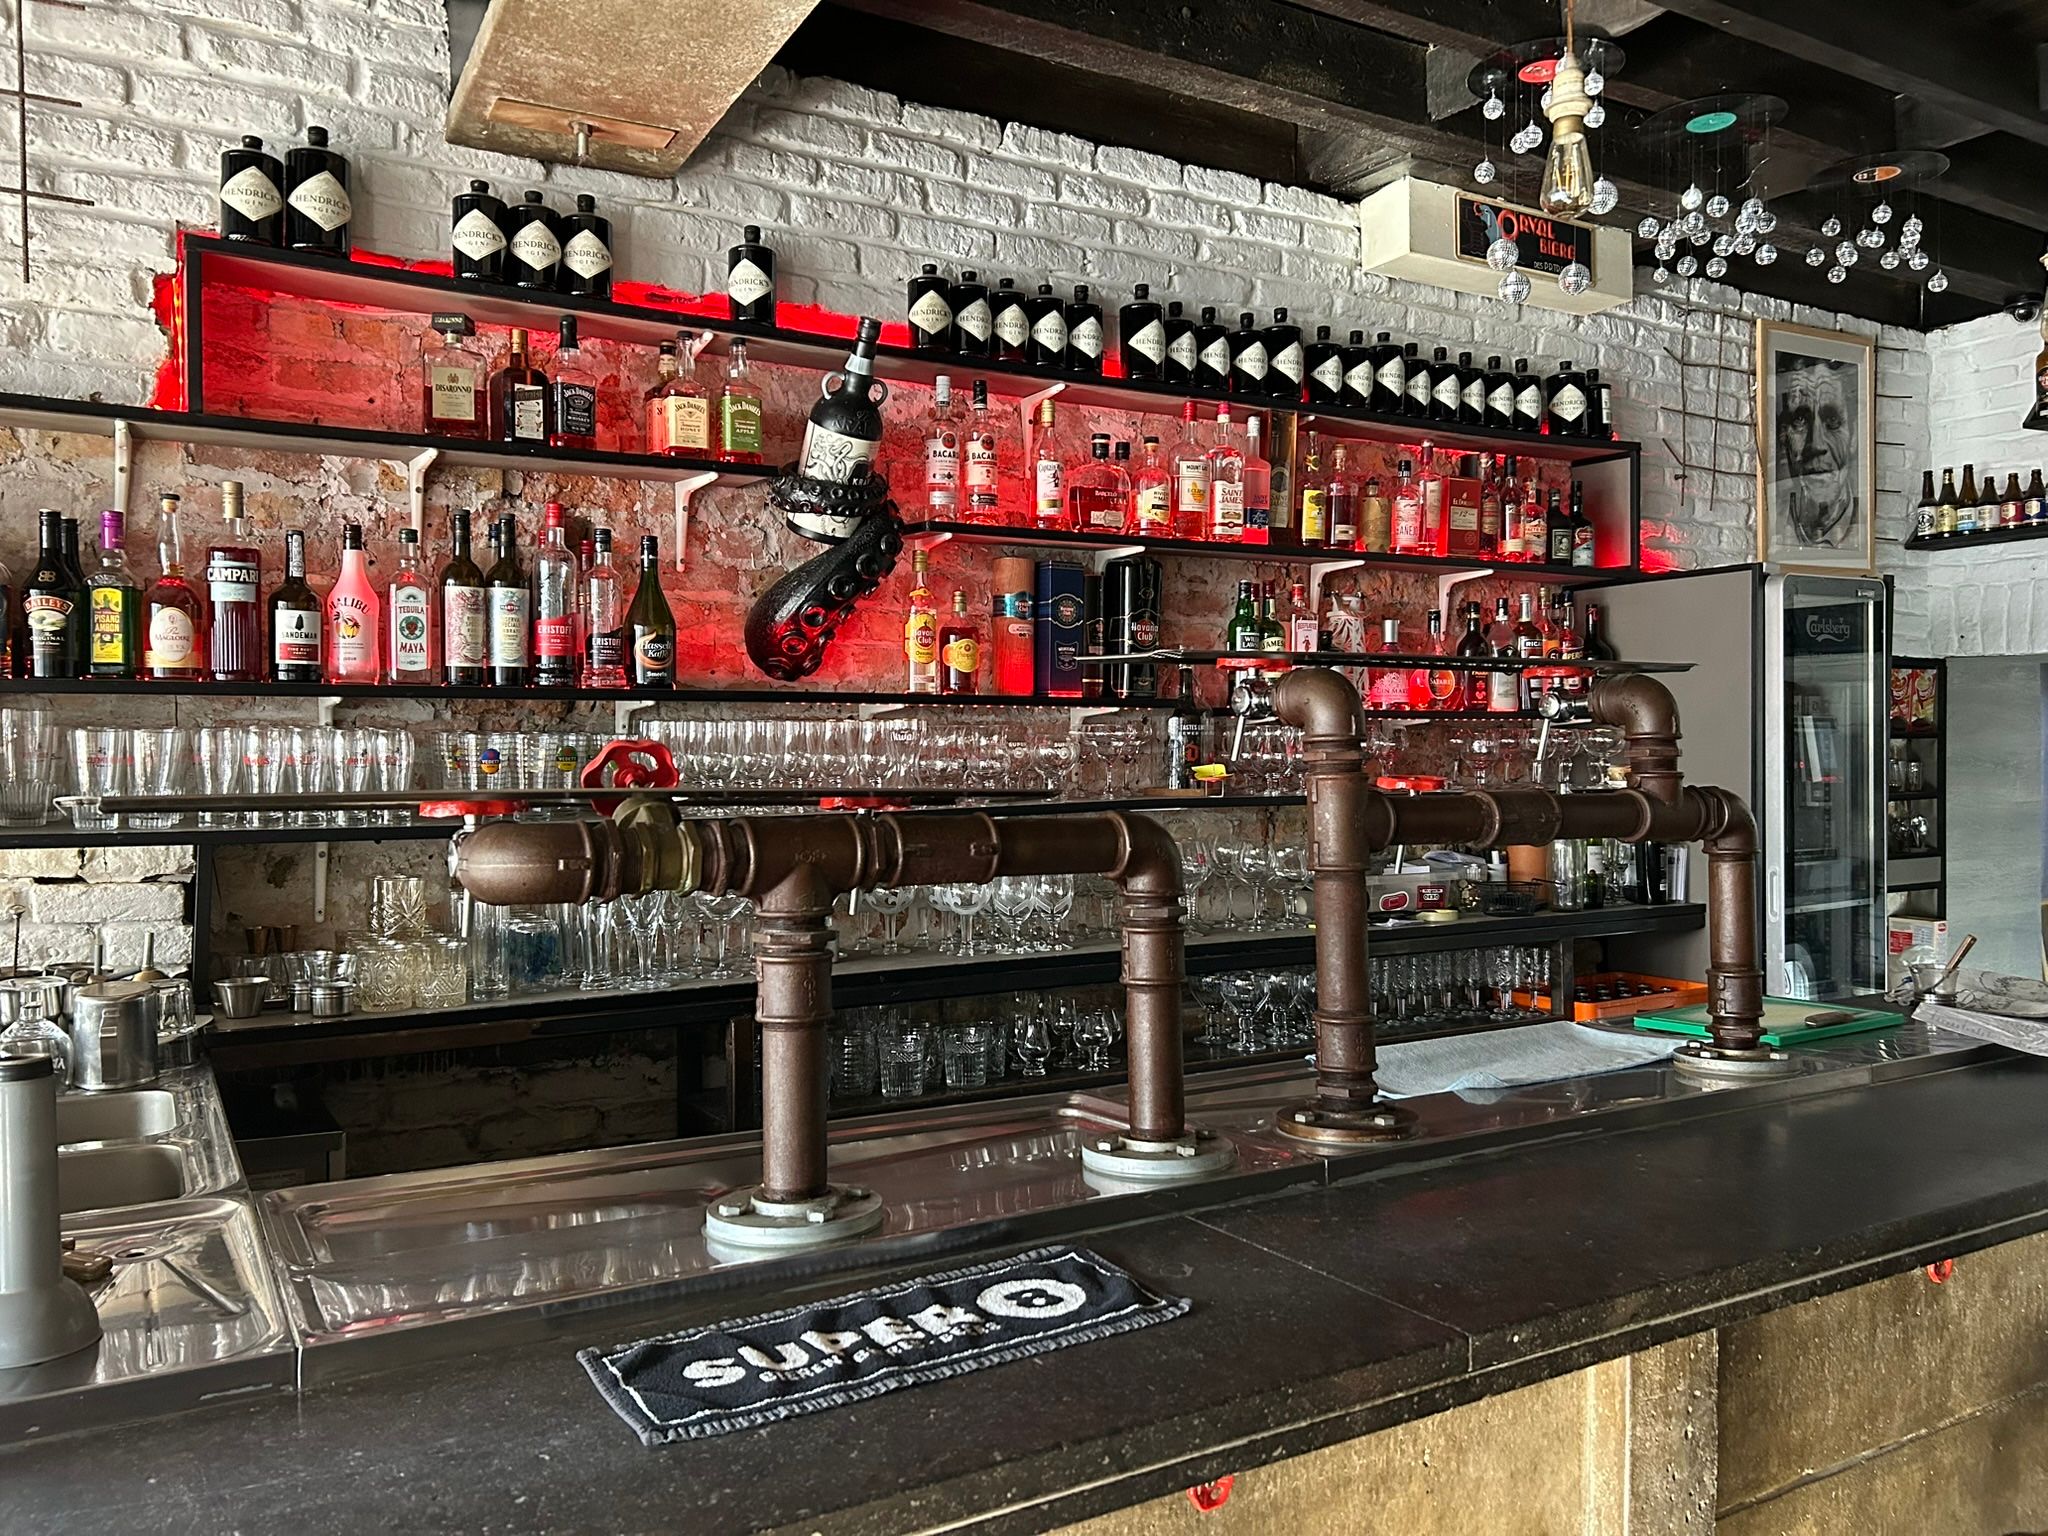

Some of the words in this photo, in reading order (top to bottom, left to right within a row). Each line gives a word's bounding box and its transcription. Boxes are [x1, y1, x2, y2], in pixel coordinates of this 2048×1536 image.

[435, 383, 472, 394] DISARONNO
[207, 567, 259, 582] CAMPARI
[25, 598, 68, 610] BAILEYS
[329, 597, 371, 615] MALIBU
[398, 606, 425, 614] TEQUILA
[94, 614, 120, 624] PISANG
[538, 624, 573, 635] ERISTOFF
[1131, 622, 1159, 632] Havana
[1806, 615, 1850, 639] Carlsberg
[281, 631, 318, 640] SANDEMAN
[917, 636, 932, 644] Club
[1137, 631, 1154, 641] Club
[592, 637, 621, 646] ERISTOFF
[399, 642, 425, 653] MAYA
[682, 1303, 987, 1388] SUPER
[758, 1355, 843, 1383] BIEREN
